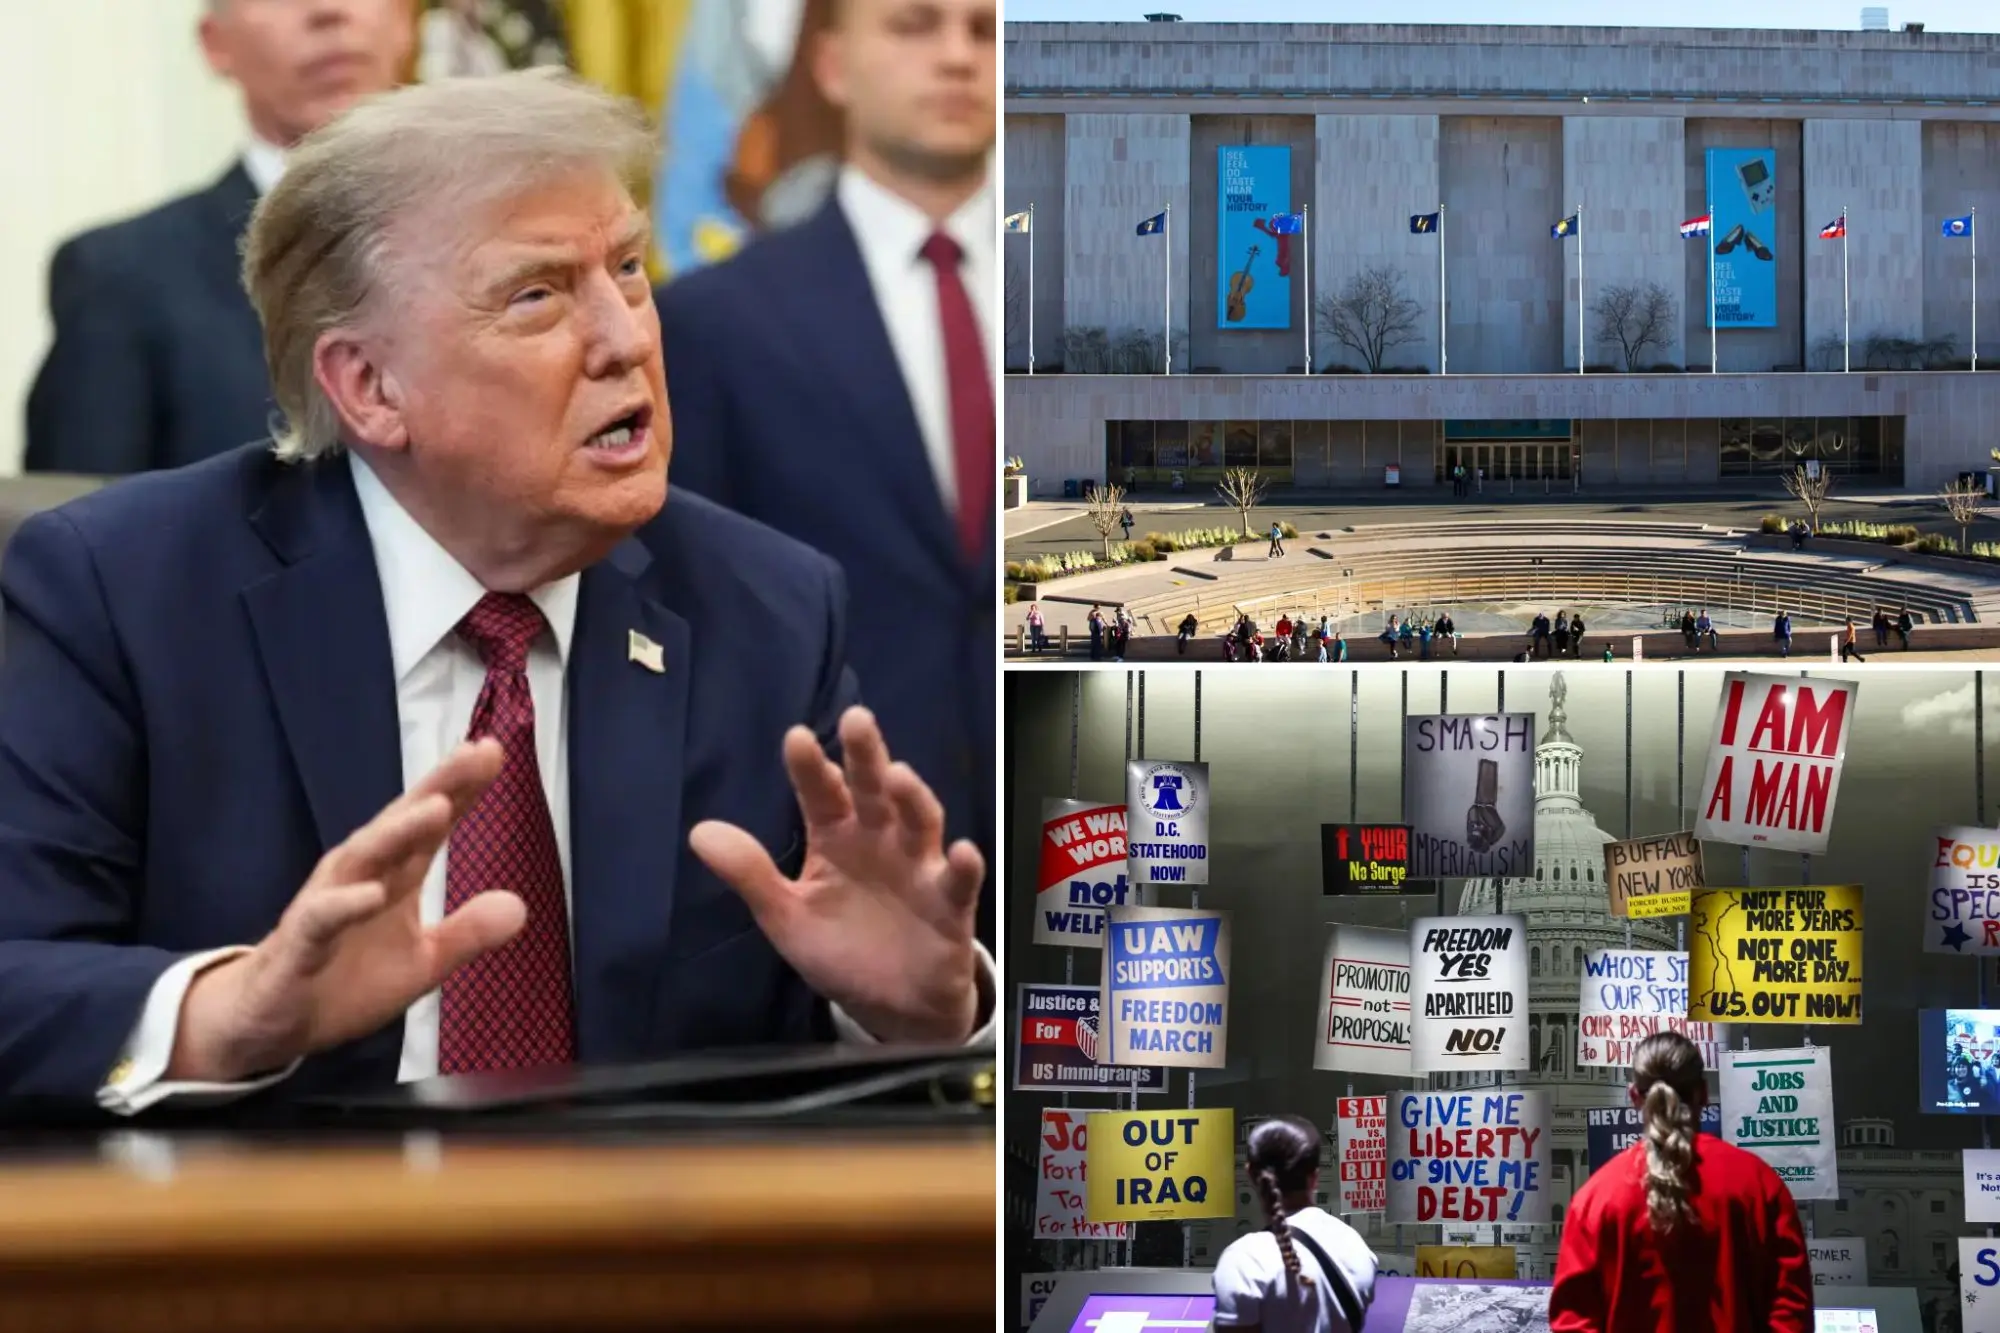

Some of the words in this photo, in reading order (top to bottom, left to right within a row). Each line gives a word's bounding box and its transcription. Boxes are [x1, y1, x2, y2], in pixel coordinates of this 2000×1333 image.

[1226, 151, 1245, 160] SEE
[1226, 160, 1249, 169] FEEL
[1226, 169, 1241, 177] DO
[1226, 177, 1255, 186] TASTE
[1226, 186, 1253, 194] HEAR
[1226, 194, 1253, 203] YOUR
[1226, 203, 1268, 212] HISTORY
[1714, 287, 1742, 296] TASTE
[1714, 295, 1740, 304] HEAR
[1714, 304, 1741, 312] YOUR
[1714, 312, 1755, 321] HISTORY
[1261, 383, 1378, 395] NATIONAL
[1390, 383, 1488, 395] MUSEUM
[1499, 383, 1523, 394] OF
[1537, 383, 1654, 395] AMERICAN
[1668, 382, 1762, 394] HISTORY
[1720, 680, 1746, 746] I
[1748, 683, 1849, 757] AM
[1417, 716, 1528, 752] SMASH
[1705, 755, 1733, 822] A
[1744, 758, 1834, 833] MAN
[1046, 819, 1086, 848] WE
[1155, 822, 1181, 837] D.C.
[1129, 843, 1206, 860] STATEHOOD
[1360, 827, 1408, 861] YOUR
[1406, 826, 1529, 878] IMPERIALISM
[1613, 836, 1701, 866] BUFFALO
[1933, 836, 2000, 869] EQU
[1150, 865, 1186, 881] NOW!
[1349, 861, 1368, 881] No
[1370, 861, 1406, 885] Surge
[1617, 869, 1660, 900] NEW
[1666, 863, 1704, 891] YORK
[1966, 874, 2000, 889] IS
[1069, 874, 1130, 906] not
[1629, 898, 1658, 907] FORCED
[1661, 895, 1689, 904] BUSING
[1740, 890, 1783, 911] NOT
[1785, 890, 1826, 910] FOUR
[1931, 887, 2000, 921] SPEC
[1746, 910, 1795, 932] MORE
[1123, 925, 1205, 956] UAW
[1423, 927, 1513, 952] FREEDOM
[1737, 938, 1784, 961] NOT
[1790, 938, 1838, 961] ONE
[1116, 957, 1214, 984] SUPPORTS
[1439, 952, 1492, 978] YES
[1583, 952, 1656, 982] WHOSE
[1753, 960, 1807, 983] MORE
[1028, 993, 1086, 1011] Justice
[1089, 997, 1100, 1012] &
[1363, 999, 1392, 1013] not
[1424, 991, 1514, 1017] APARTHEID
[1600, 984, 1643, 1011] OUR
[1710, 991, 1750, 1017] U.S.
[1753, 991, 1801, 1017] OUT
[1806, 992, 1862, 1018] NOW!
[1121, 998, 1223, 1025] FREEDOM
[1035, 1022, 1062, 1039] For
[1581, 1014, 1615, 1038] OUR
[1129, 1028, 1212, 1053] MARCH
[1446, 1027, 1506, 1052] NO!
[1580, 1041, 1598, 1061] to
[1032, 1063, 1053, 1080] US
[1401, 1095, 1473, 1128] GIVE
[1483, 1094, 1525, 1125] ME
[1757, 1095, 1799, 1114] AND
[1356, 1118, 1386, 1128] Brow
[1588, 1109, 1622, 1126] HEY
[1122, 1118, 1200, 1147] OUT
[1350, 1137, 1386, 1149] Board
[1145, 1151, 1179, 1172] OF
[1357, 1181, 1374, 1190] THE
[1391, 1159, 1421, 1181] or
[1498, 1160, 1540, 1192] ME
[1976, 1171, 1993, 1181] It's
[1116, 1175, 1208, 1206] IRAQ
[1345, 1190, 1371, 1200] CIVIL
[1038, 1216, 1066, 1234] For
[1072, 1215, 1100, 1237] the
